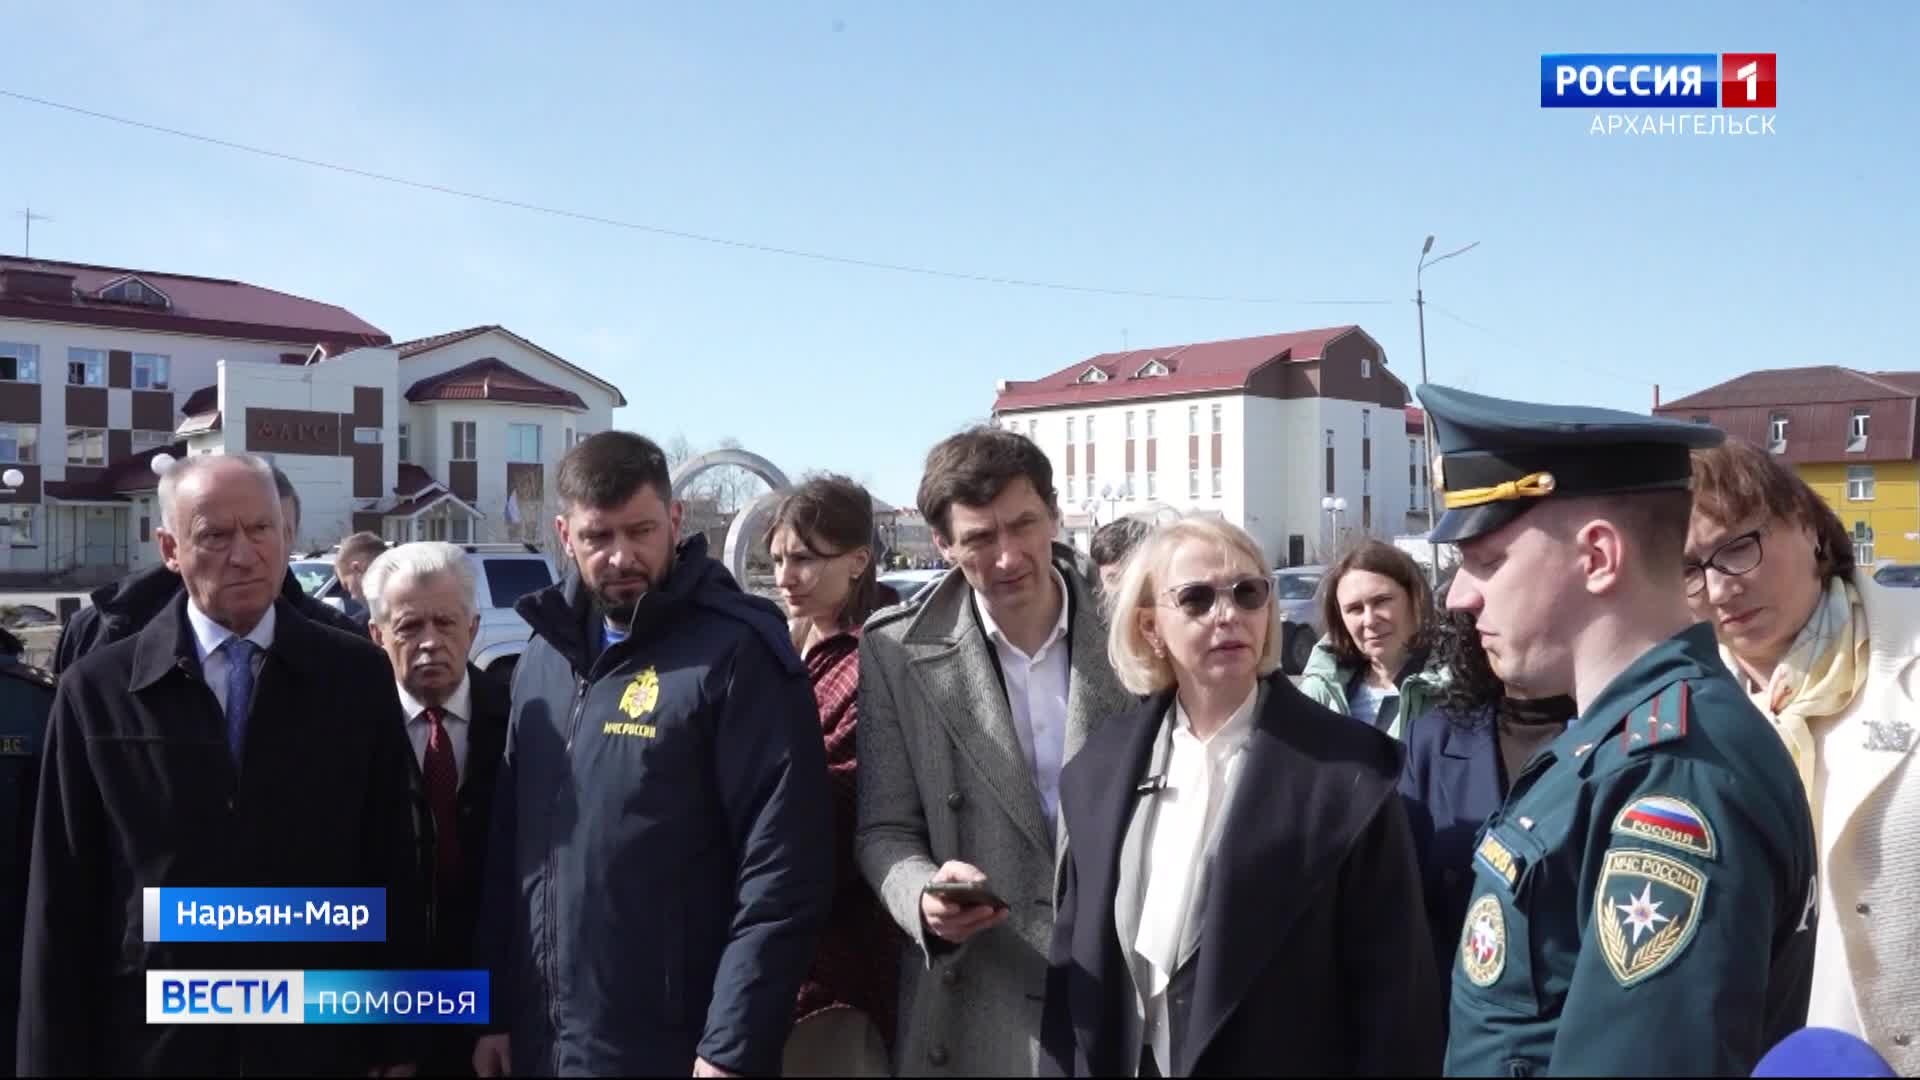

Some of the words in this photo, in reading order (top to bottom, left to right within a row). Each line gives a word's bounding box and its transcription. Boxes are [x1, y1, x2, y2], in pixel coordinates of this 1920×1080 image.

[603, 721, 623, 735] МЧС
[622, 722, 657, 738] РОССИИ
[1631, 819, 1694, 846] РОССИЯ
[1610, 856, 1642, 871] МЧС
[1641, 858, 1698, 890] РОССИИ
